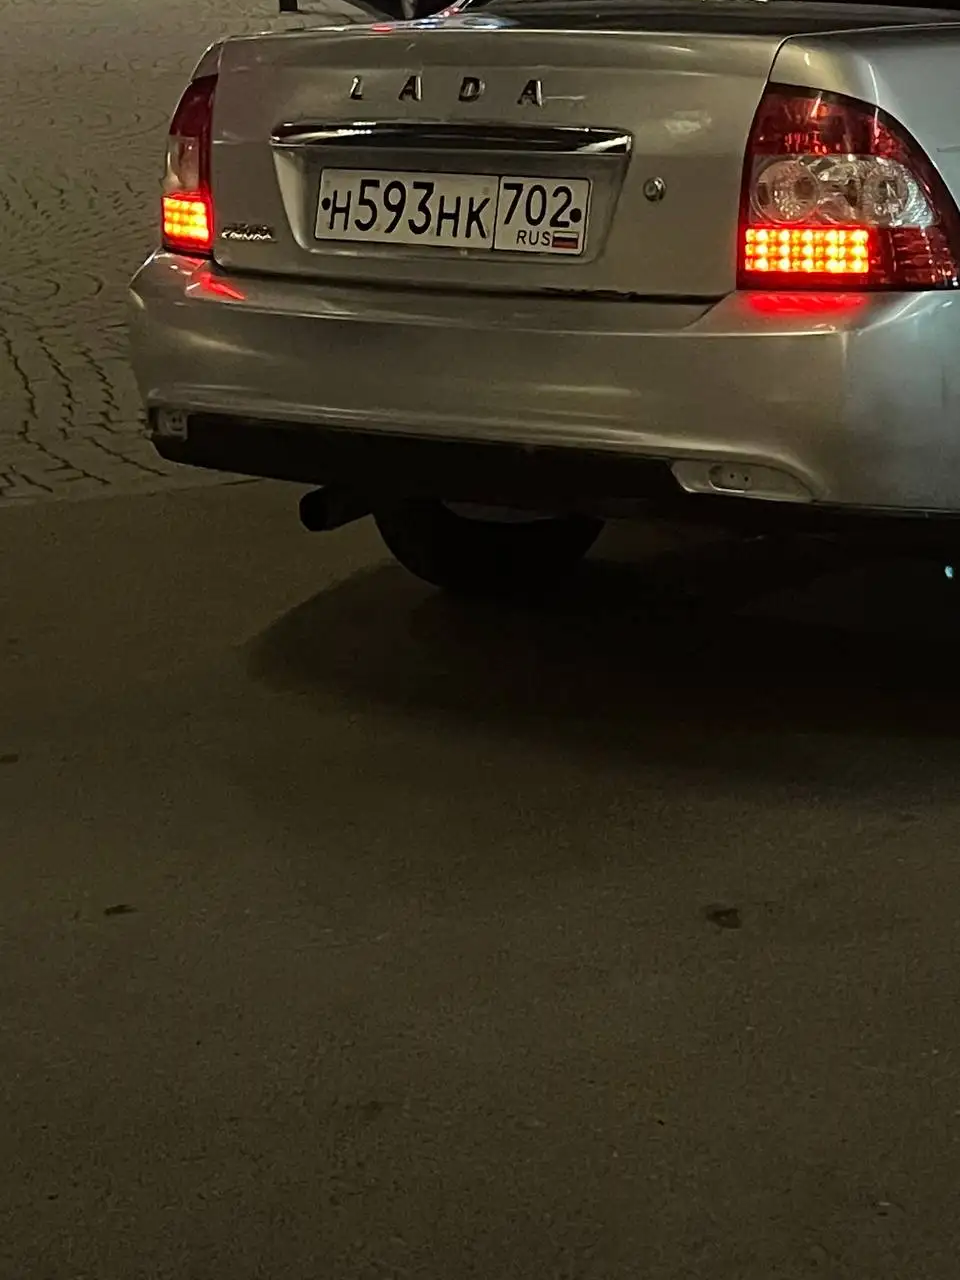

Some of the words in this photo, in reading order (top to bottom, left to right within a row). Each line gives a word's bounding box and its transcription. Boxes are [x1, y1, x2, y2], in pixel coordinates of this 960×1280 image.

[349, 75, 543, 107] LADA
[329, 179, 491, 239] Н593НК
[503, 183, 573, 228] 702
[516, 230, 551, 246] RUS
